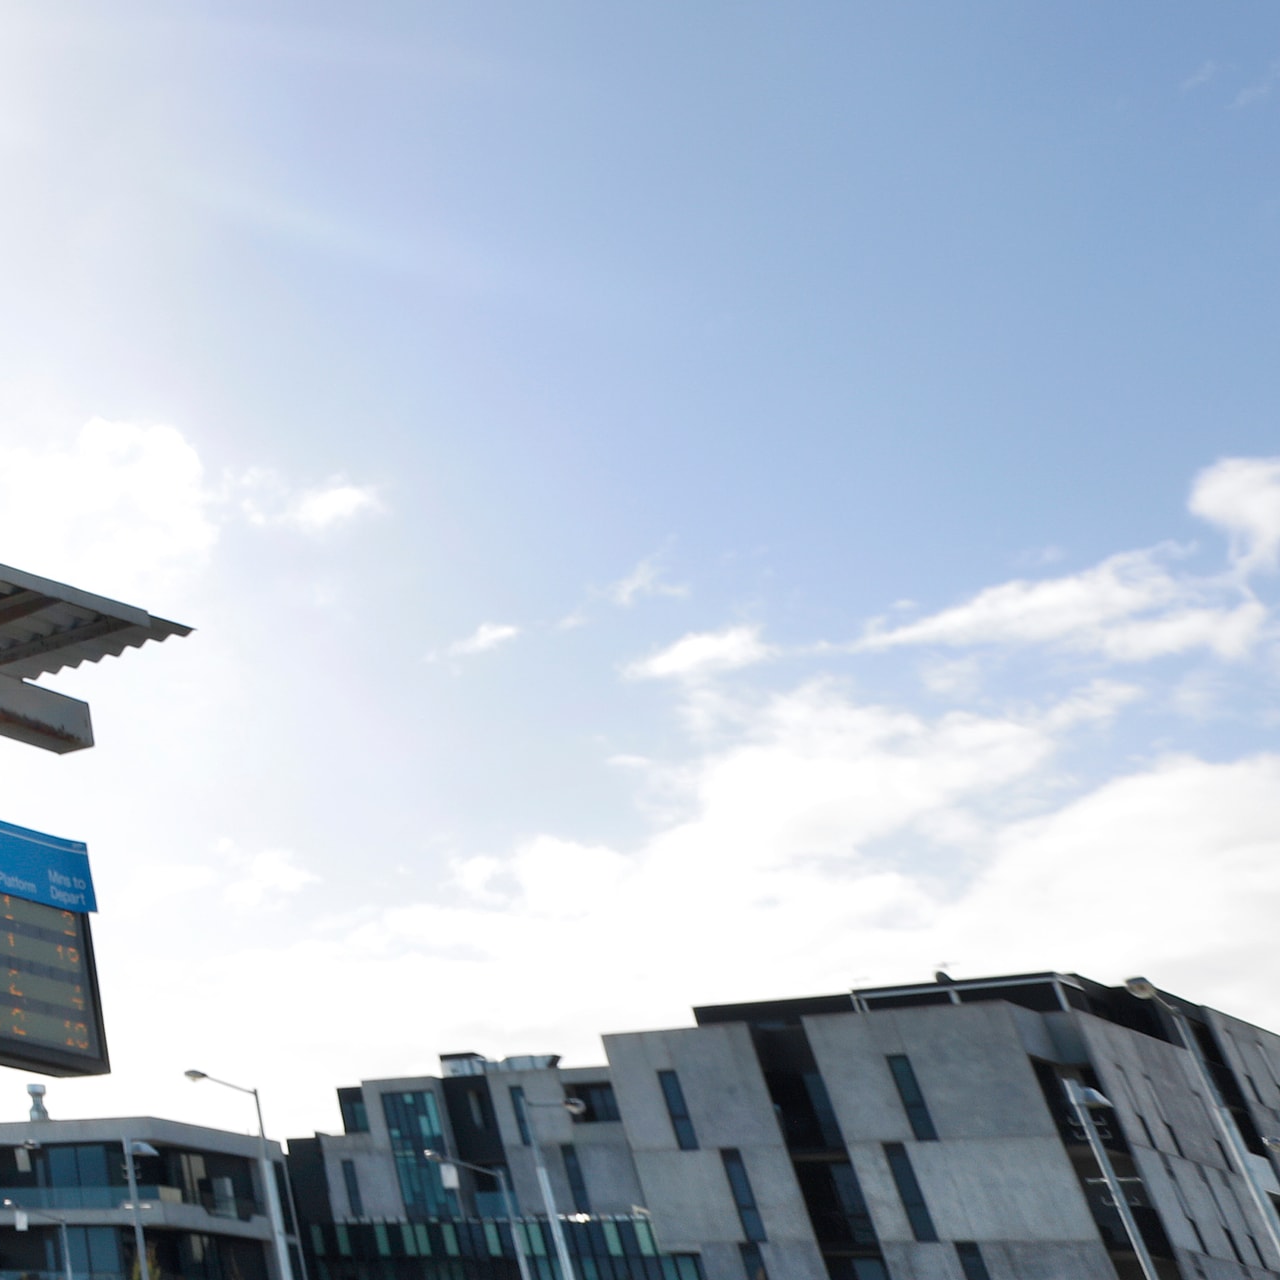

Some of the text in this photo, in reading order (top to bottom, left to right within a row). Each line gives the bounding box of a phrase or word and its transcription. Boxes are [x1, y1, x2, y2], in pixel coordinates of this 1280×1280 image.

[47, 869, 87, 890] Mins to
[50, 885, 87, 906] Depart
